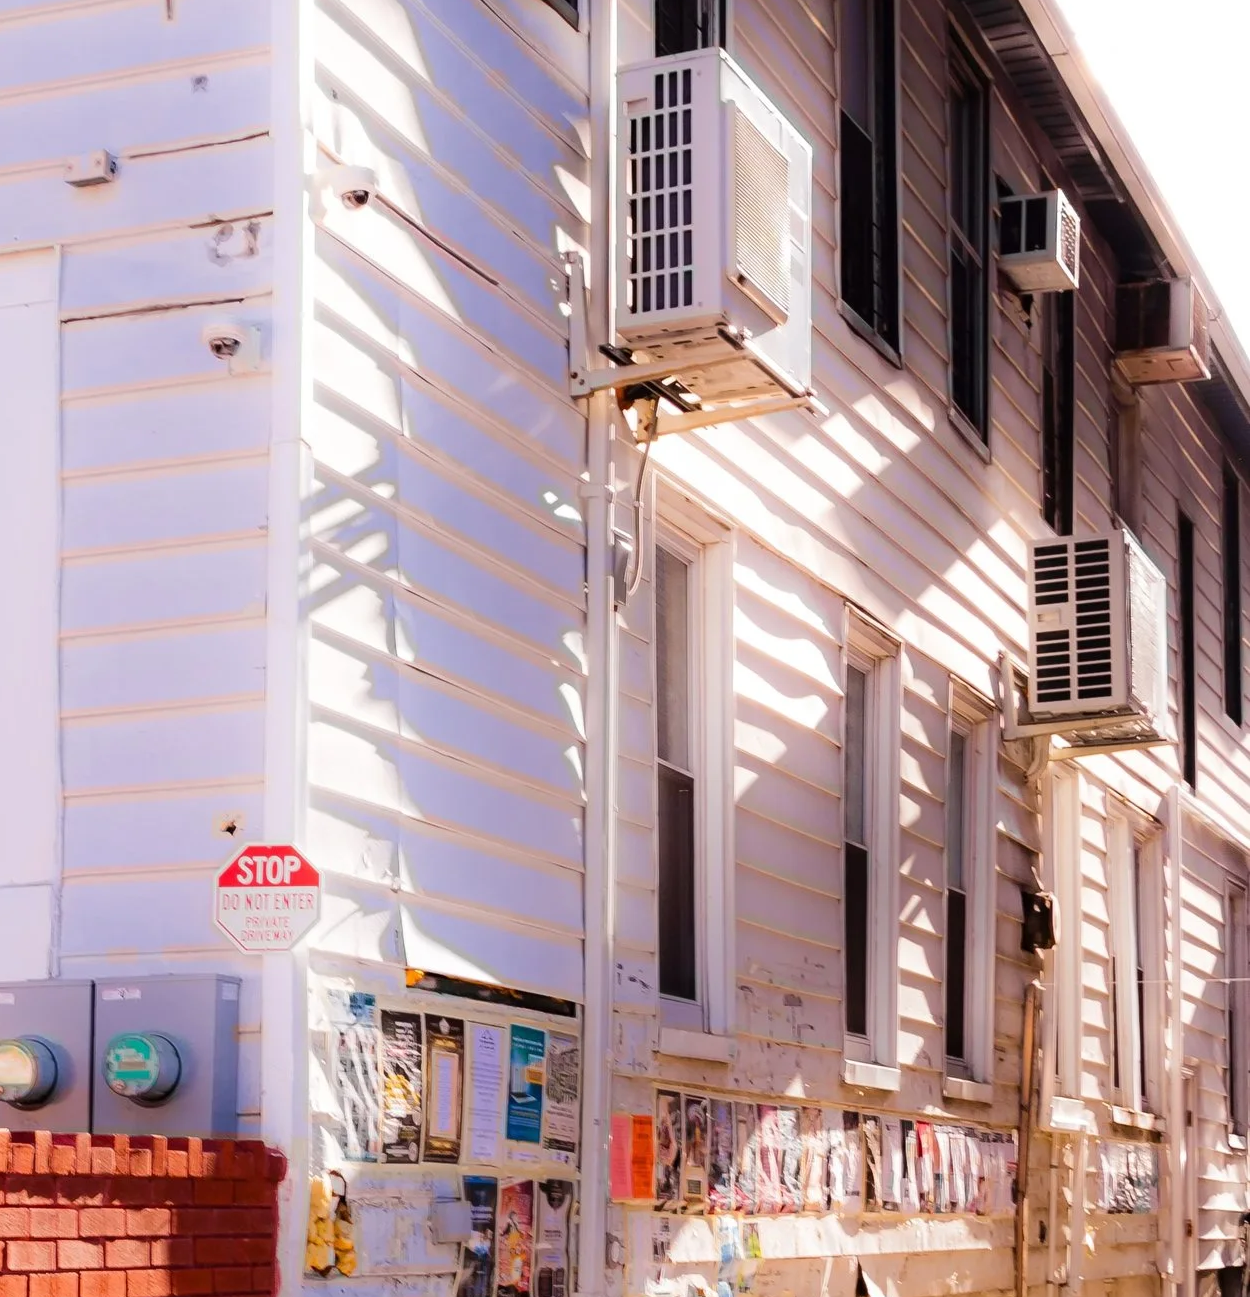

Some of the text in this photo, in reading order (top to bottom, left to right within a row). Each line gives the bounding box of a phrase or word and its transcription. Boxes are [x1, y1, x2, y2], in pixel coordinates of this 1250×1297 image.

[236, 855, 302, 885] STOP
[223, 892, 315, 911] DO NOT ENTER
[245, 916, 291, 928] PRIVATE
